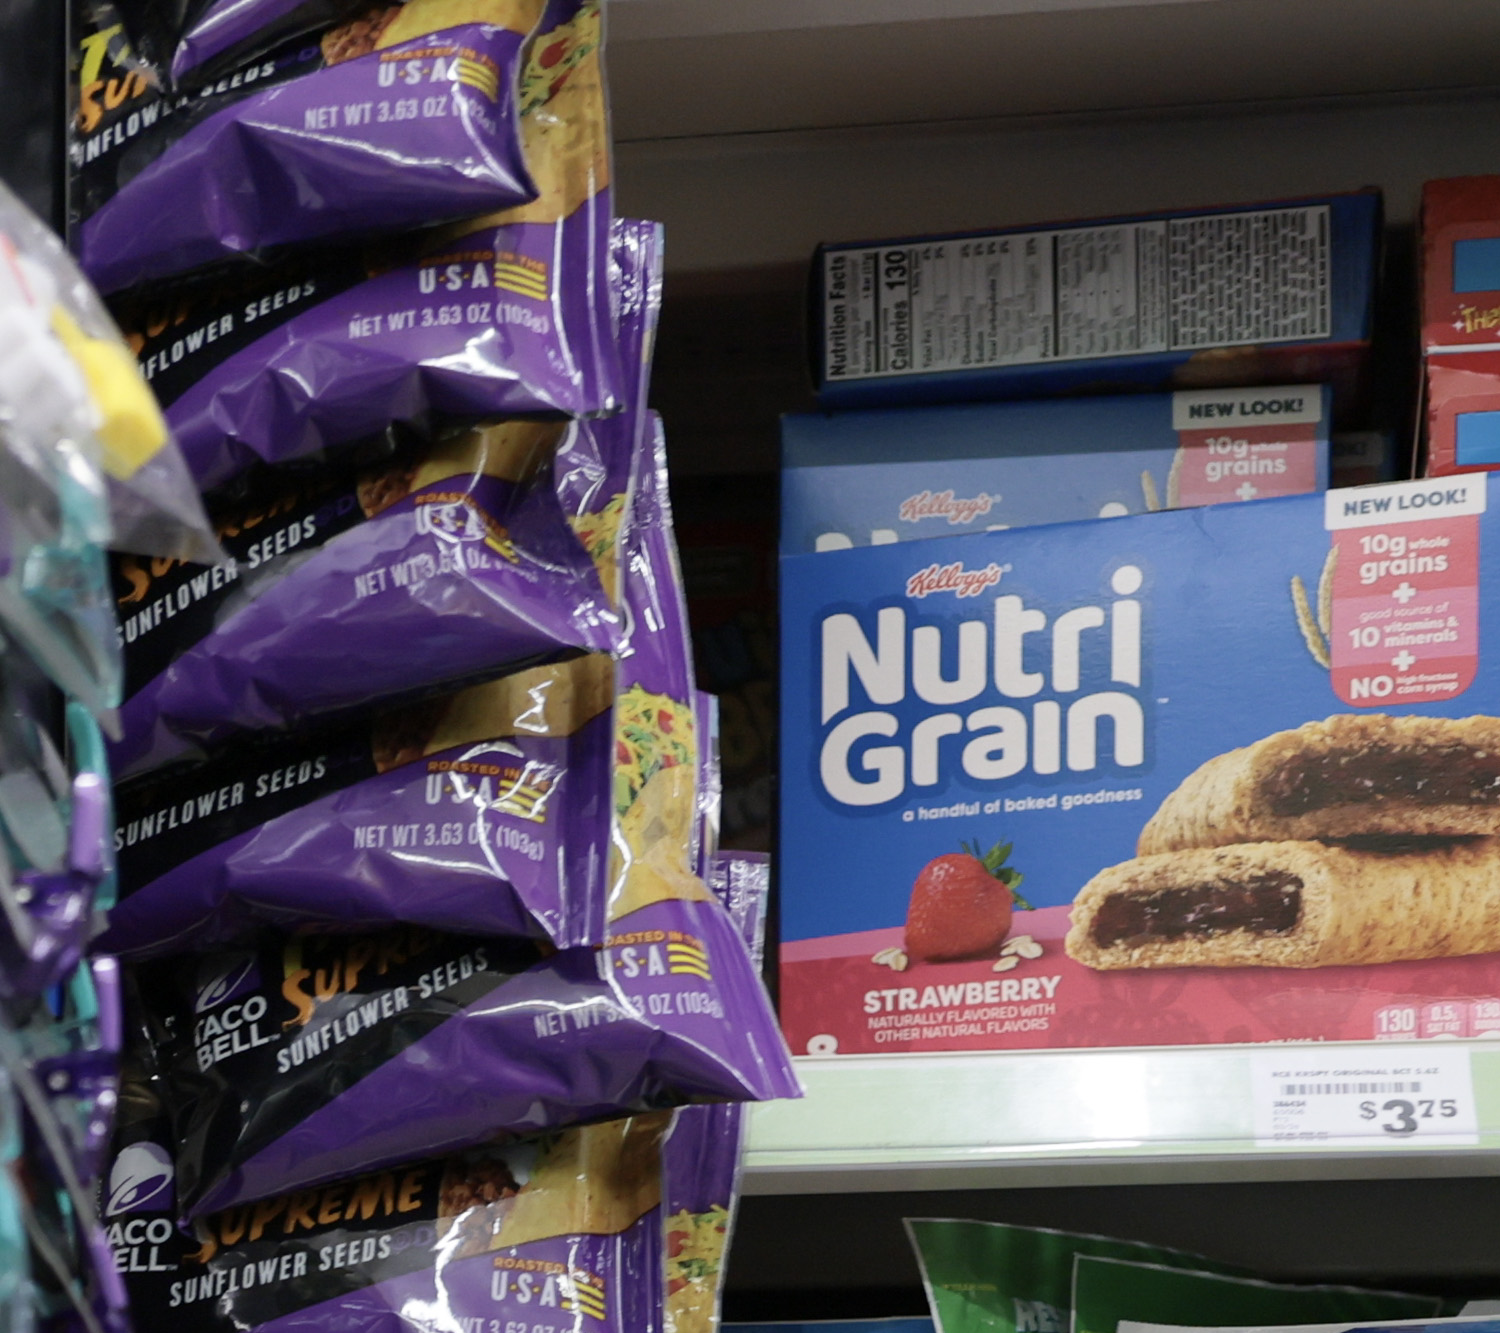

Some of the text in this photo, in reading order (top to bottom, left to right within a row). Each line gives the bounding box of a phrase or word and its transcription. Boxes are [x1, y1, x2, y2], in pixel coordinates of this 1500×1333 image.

[1343, 487, 1467, 516] NEW LOOK!
[906, 561, 1004, 597] Kellogg's
[1359, 551, 1448, 578] grains
[821, 563, 1143, 727] Nutri
[1350, 628, 1379, 649] 10
[1350, 675, 1394, 699] NO
[820, 689, 1145, 807] Grain
[113, 755, 328, 853] SUNFLOWER SEEDS
[916, 798, 981, 820] handful
[985, 798, 1001, 815] of
[1004, 793, 1057, 813] baked
[1061, 788, 1143, 813] goodness
[863, 976, 1062, 1015] STRAWBERRY
[868, 1003, 1057, 1033] NATURALLY FLAVORED WITH
[874, 1015, 1050, 1045] OTHER NATURAL FLAVORS
